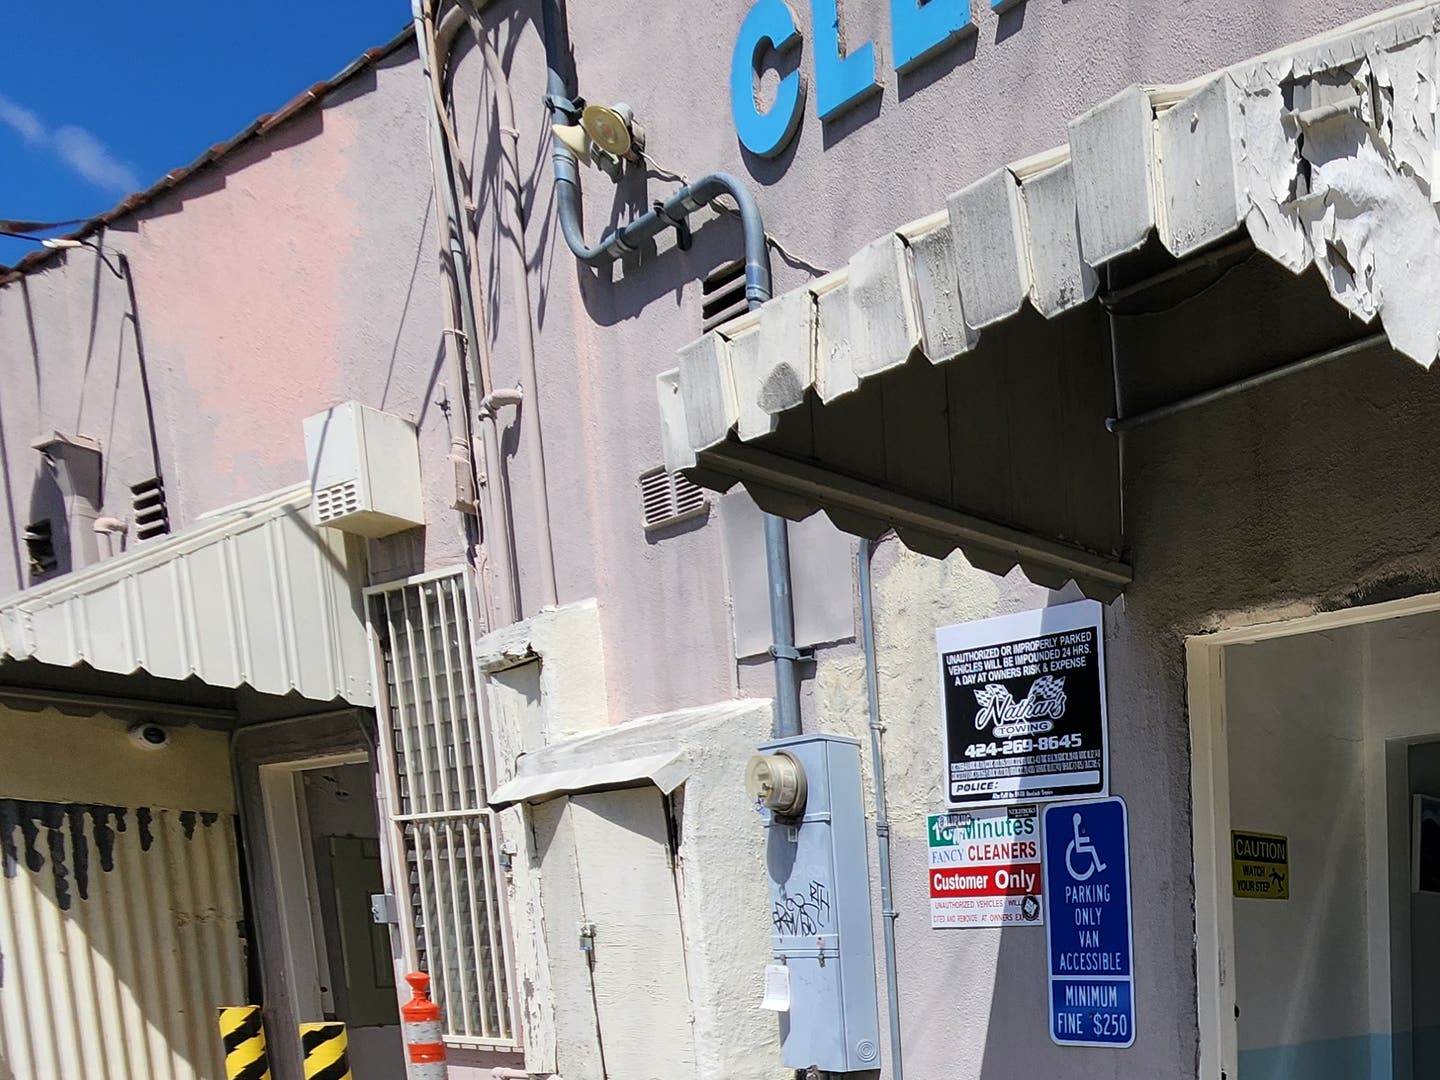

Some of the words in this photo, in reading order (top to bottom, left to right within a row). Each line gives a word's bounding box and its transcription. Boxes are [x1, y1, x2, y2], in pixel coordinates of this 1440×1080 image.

[946, 646, 1000, 664] UNAUTHORIZED
[1000, 645, 1012, 656] OR
[1013, 637, 1058, 654] IMPROPERLY
[1059, 631, 1092, 646] PARKED
[948, 661, 983, 676] VEHICLES
[984, 660, 1002, 671] WILL
[1003, 657, 1014, 668] BE
[1015, 649, 1061, 665] IMPOUNDED
[1062, 646, 1071, 656] 24
[1072, 643, 1092, 655] HRS.
[954, 676, 962, 687] A
[962, 674, 977, 685] DAY
[977, 672, 987, 683] AT
[988, 666, 1022, 681] OWNERS
[1023, 663, 1041, 676] RISK
[1042, 662, 1049, 672] &
[1050, 656, 1087, 671] EXPENSE
[999, 722, 1048, 735] TOWING
[964, 733, 1083, 758] 424-269-8645
[956, 781, 999, 793] POLICE:
[962, 817, 1035, 840] Minutes
[932, 848, 964, 864] FANCY
[967, 841, 1037, 861] CLEANERS
[1235, 838, 1286, 860] CAUTION
[933, 873, 989, 891] Customer
[994, 869, 1036, 892] Only
[1242, 864, 1265, 877] WATCH
[1065, 884, 1111, 904] PARKING
[1237, 879, 1254, 892] YOUR
[1254, 881, 1270, 893] STEP
[935, 901, 974, 909] UNAUTHORIZED
[977, 899, 1003, 908] VEHICLES
[990, 913, 1013, 922] OWNERS
[1075, 907, 1102, 925] ONLY
[1079, 930, 1099, 948] VAN
[1059, 952, 1122, 971] ACCESSIBLE
[1065, 985, 1118, 1008] MINIMUM
[1058, 1012, 1084, 1035] FINE
[1093, 1012, 1127, 1038] $250
